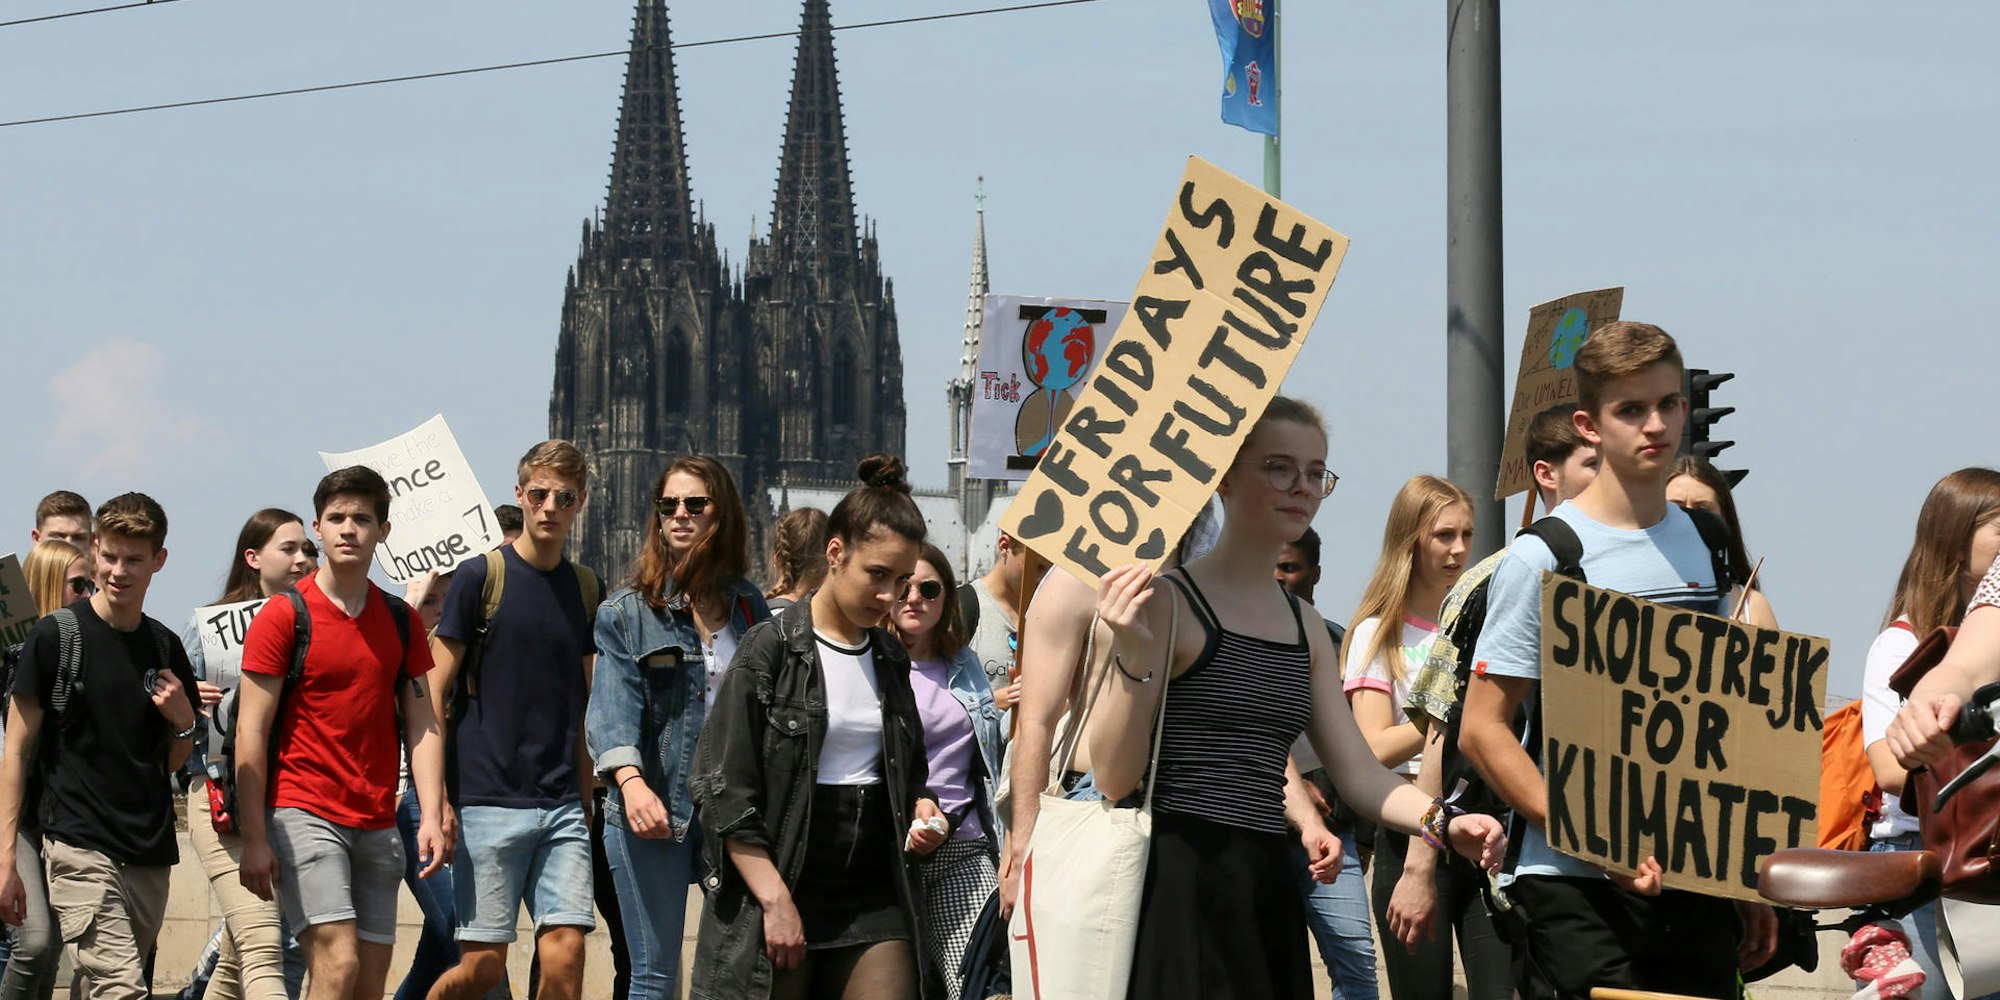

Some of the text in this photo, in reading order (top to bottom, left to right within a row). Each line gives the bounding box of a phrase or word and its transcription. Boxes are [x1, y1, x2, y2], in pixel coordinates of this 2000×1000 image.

[981, 371, 1021, 402] Tick
[1038, 180, 1235, 497] FRIDAYS
[1149, 202, 1333, 485] FUTURE
[206, 601, 263, 650] FUT
[1552, 581, 1829, 732] SKOLSTREJK
[1621, 688, 1730, 772] FÖR
[1549, 737, 1817, 889] KLIMATET
